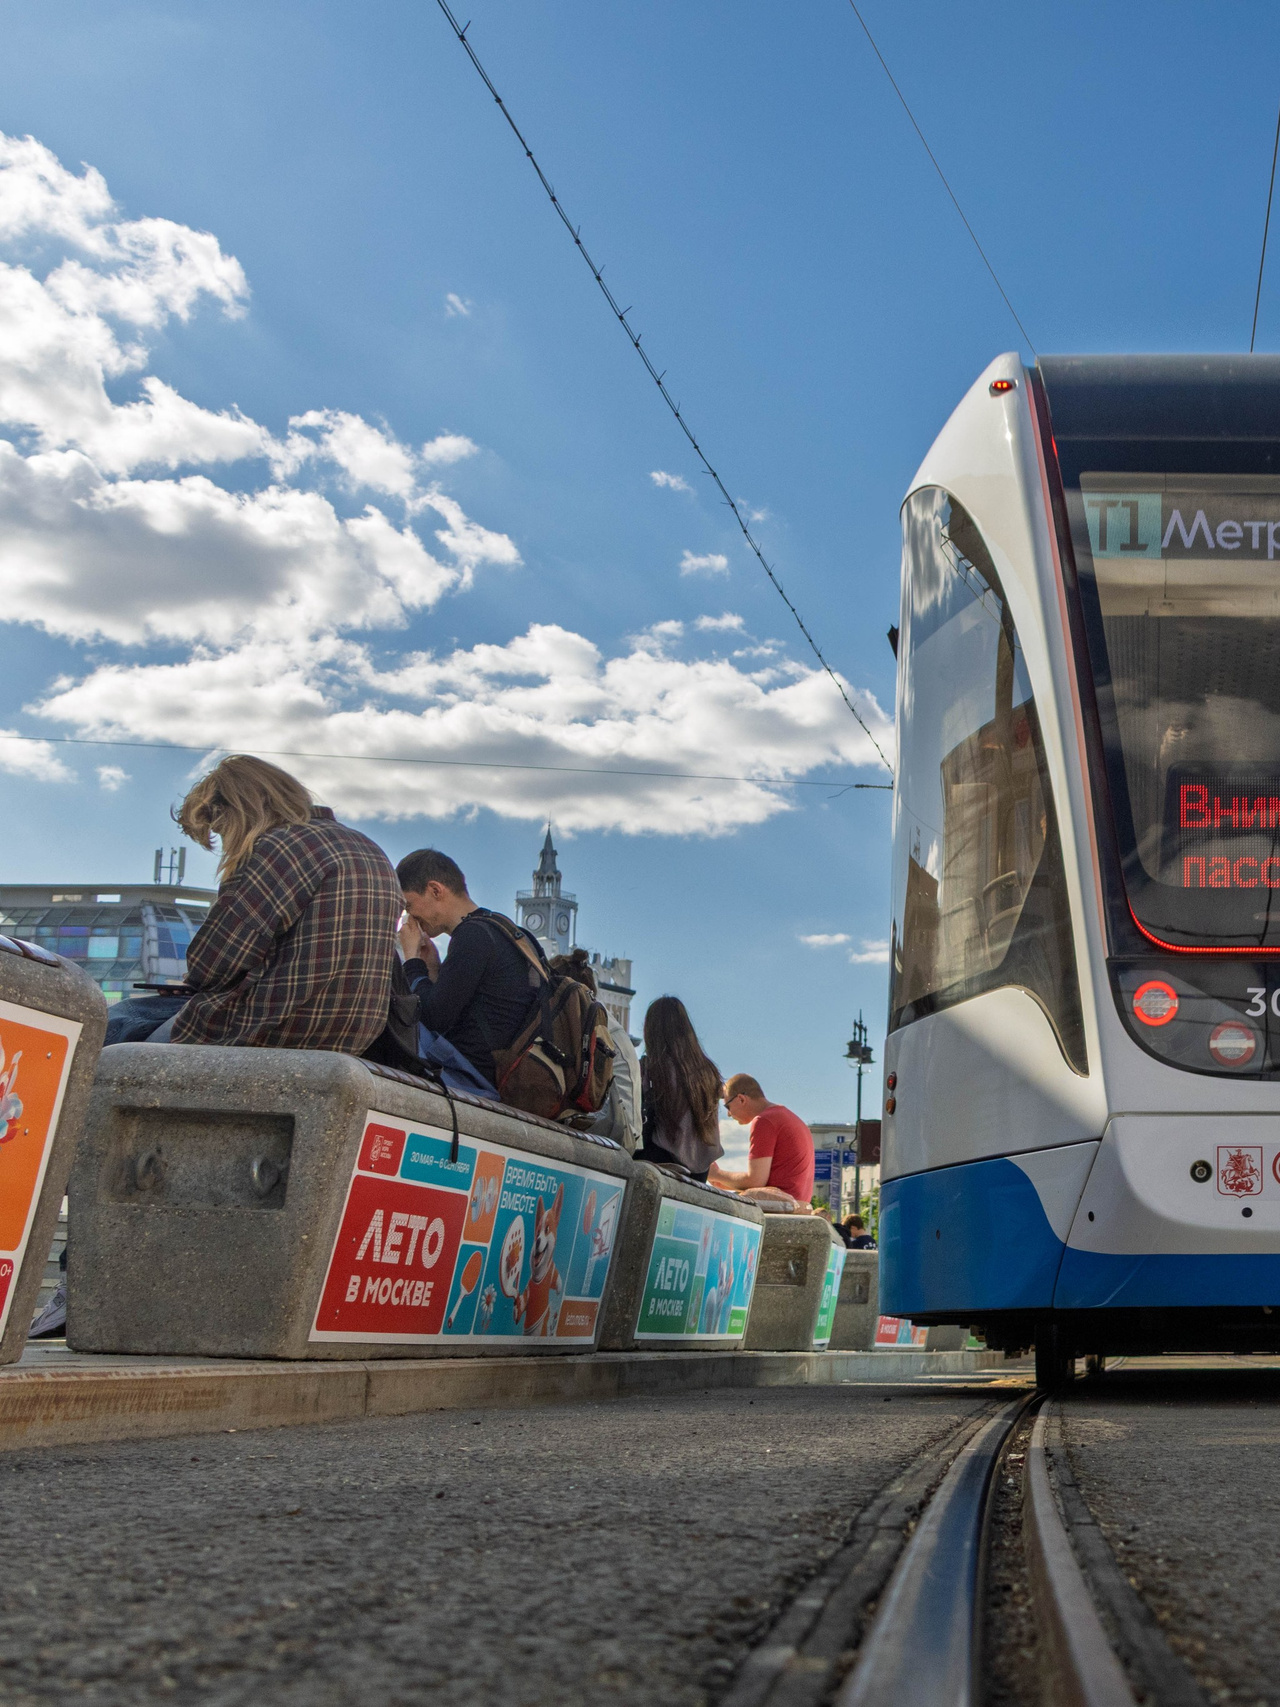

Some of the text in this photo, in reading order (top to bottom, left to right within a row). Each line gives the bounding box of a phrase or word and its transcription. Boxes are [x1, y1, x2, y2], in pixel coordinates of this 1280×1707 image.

[410, 1151, 420, 1163] 30
[419, 1153, 434, 1166] МАЯ
[439, 1158, 444, 1168] 6
[505, 1166, 558, 1194] ВРЕМЯ БЫТЬ
[500, 1191, 536, 1214] ВМЕСТЕ
[355, 1209, 445, 1269] ЛЕТО
[0, 1263, 12, 1277] 0+
[654, 1256, 690, 1292] ЛЕТО
[345, 1275, 435, 1307] В МОСКВЕ
[649, 1298, 684, 1317] В МОСКВЕ
